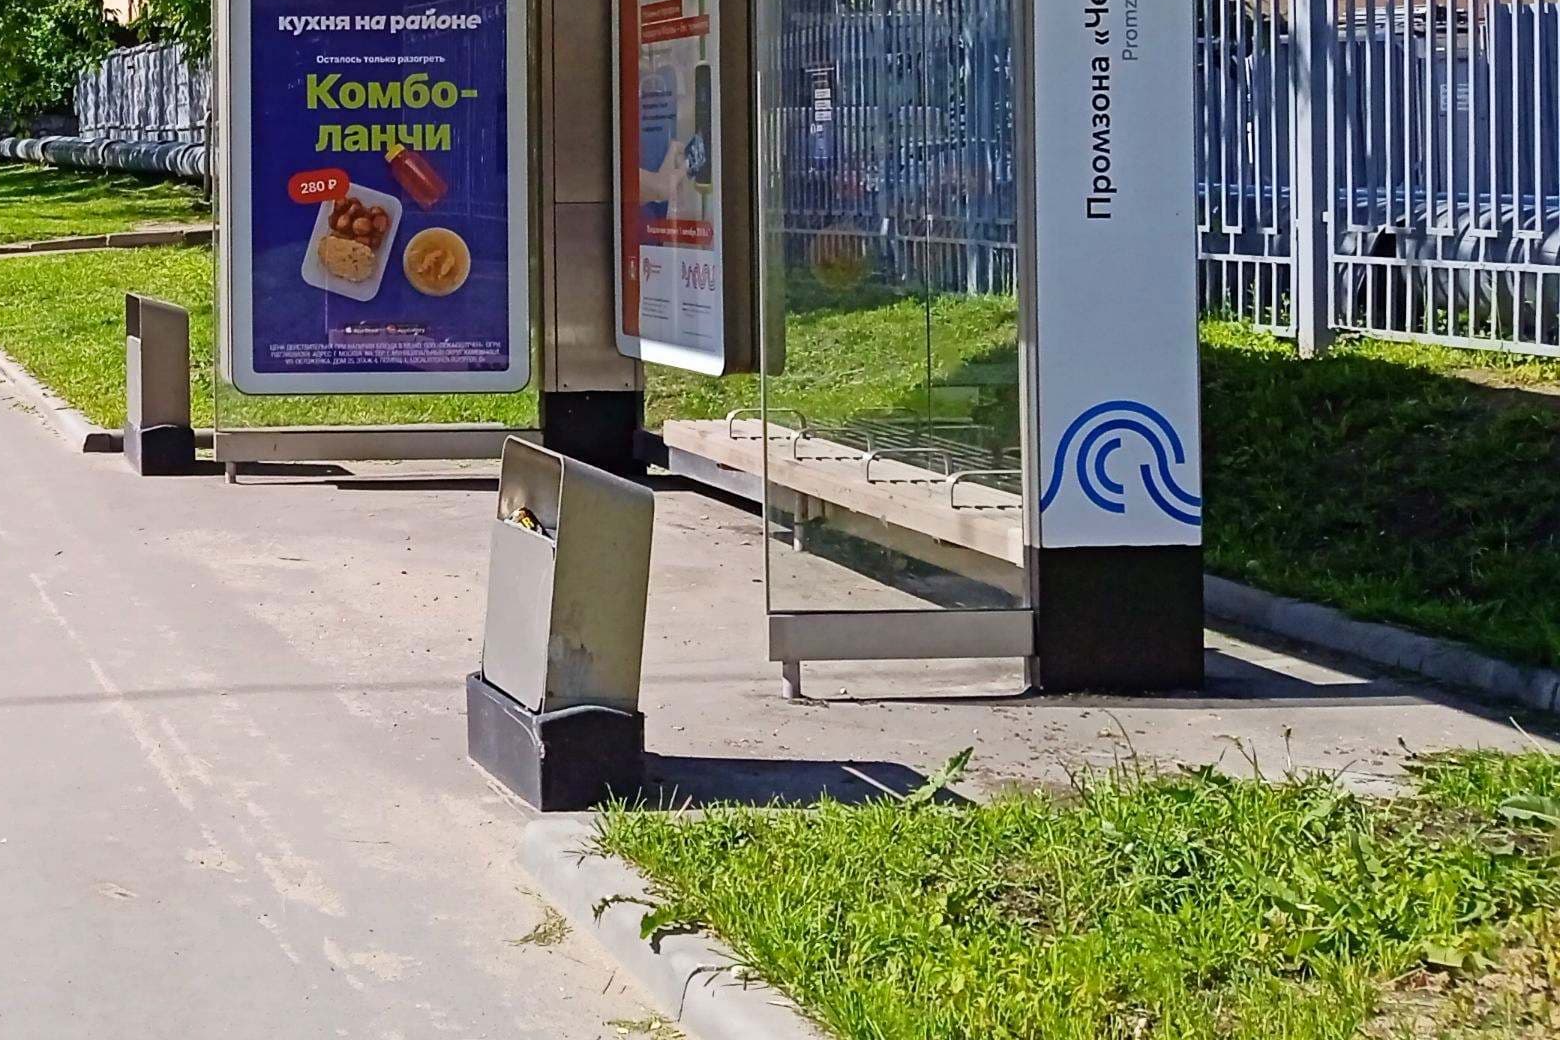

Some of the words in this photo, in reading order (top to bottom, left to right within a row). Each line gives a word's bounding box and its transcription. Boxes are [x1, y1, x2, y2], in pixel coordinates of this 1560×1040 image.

[278, 15, 351, 36] кухня
[355, 15, 386, 31] на
[390, 9, 482, 34] районе
[316, 55, 362, 64] Осталось
[363, 55, 396, 63] только
[397, 55, 446, 64] разогреть
[306, 73, 478, 109] Комбо-
[315, 124, 451, 152] ланчи
[1087, 56, 1117, 220] Промзона
[300, 180, 325, 195] 280
